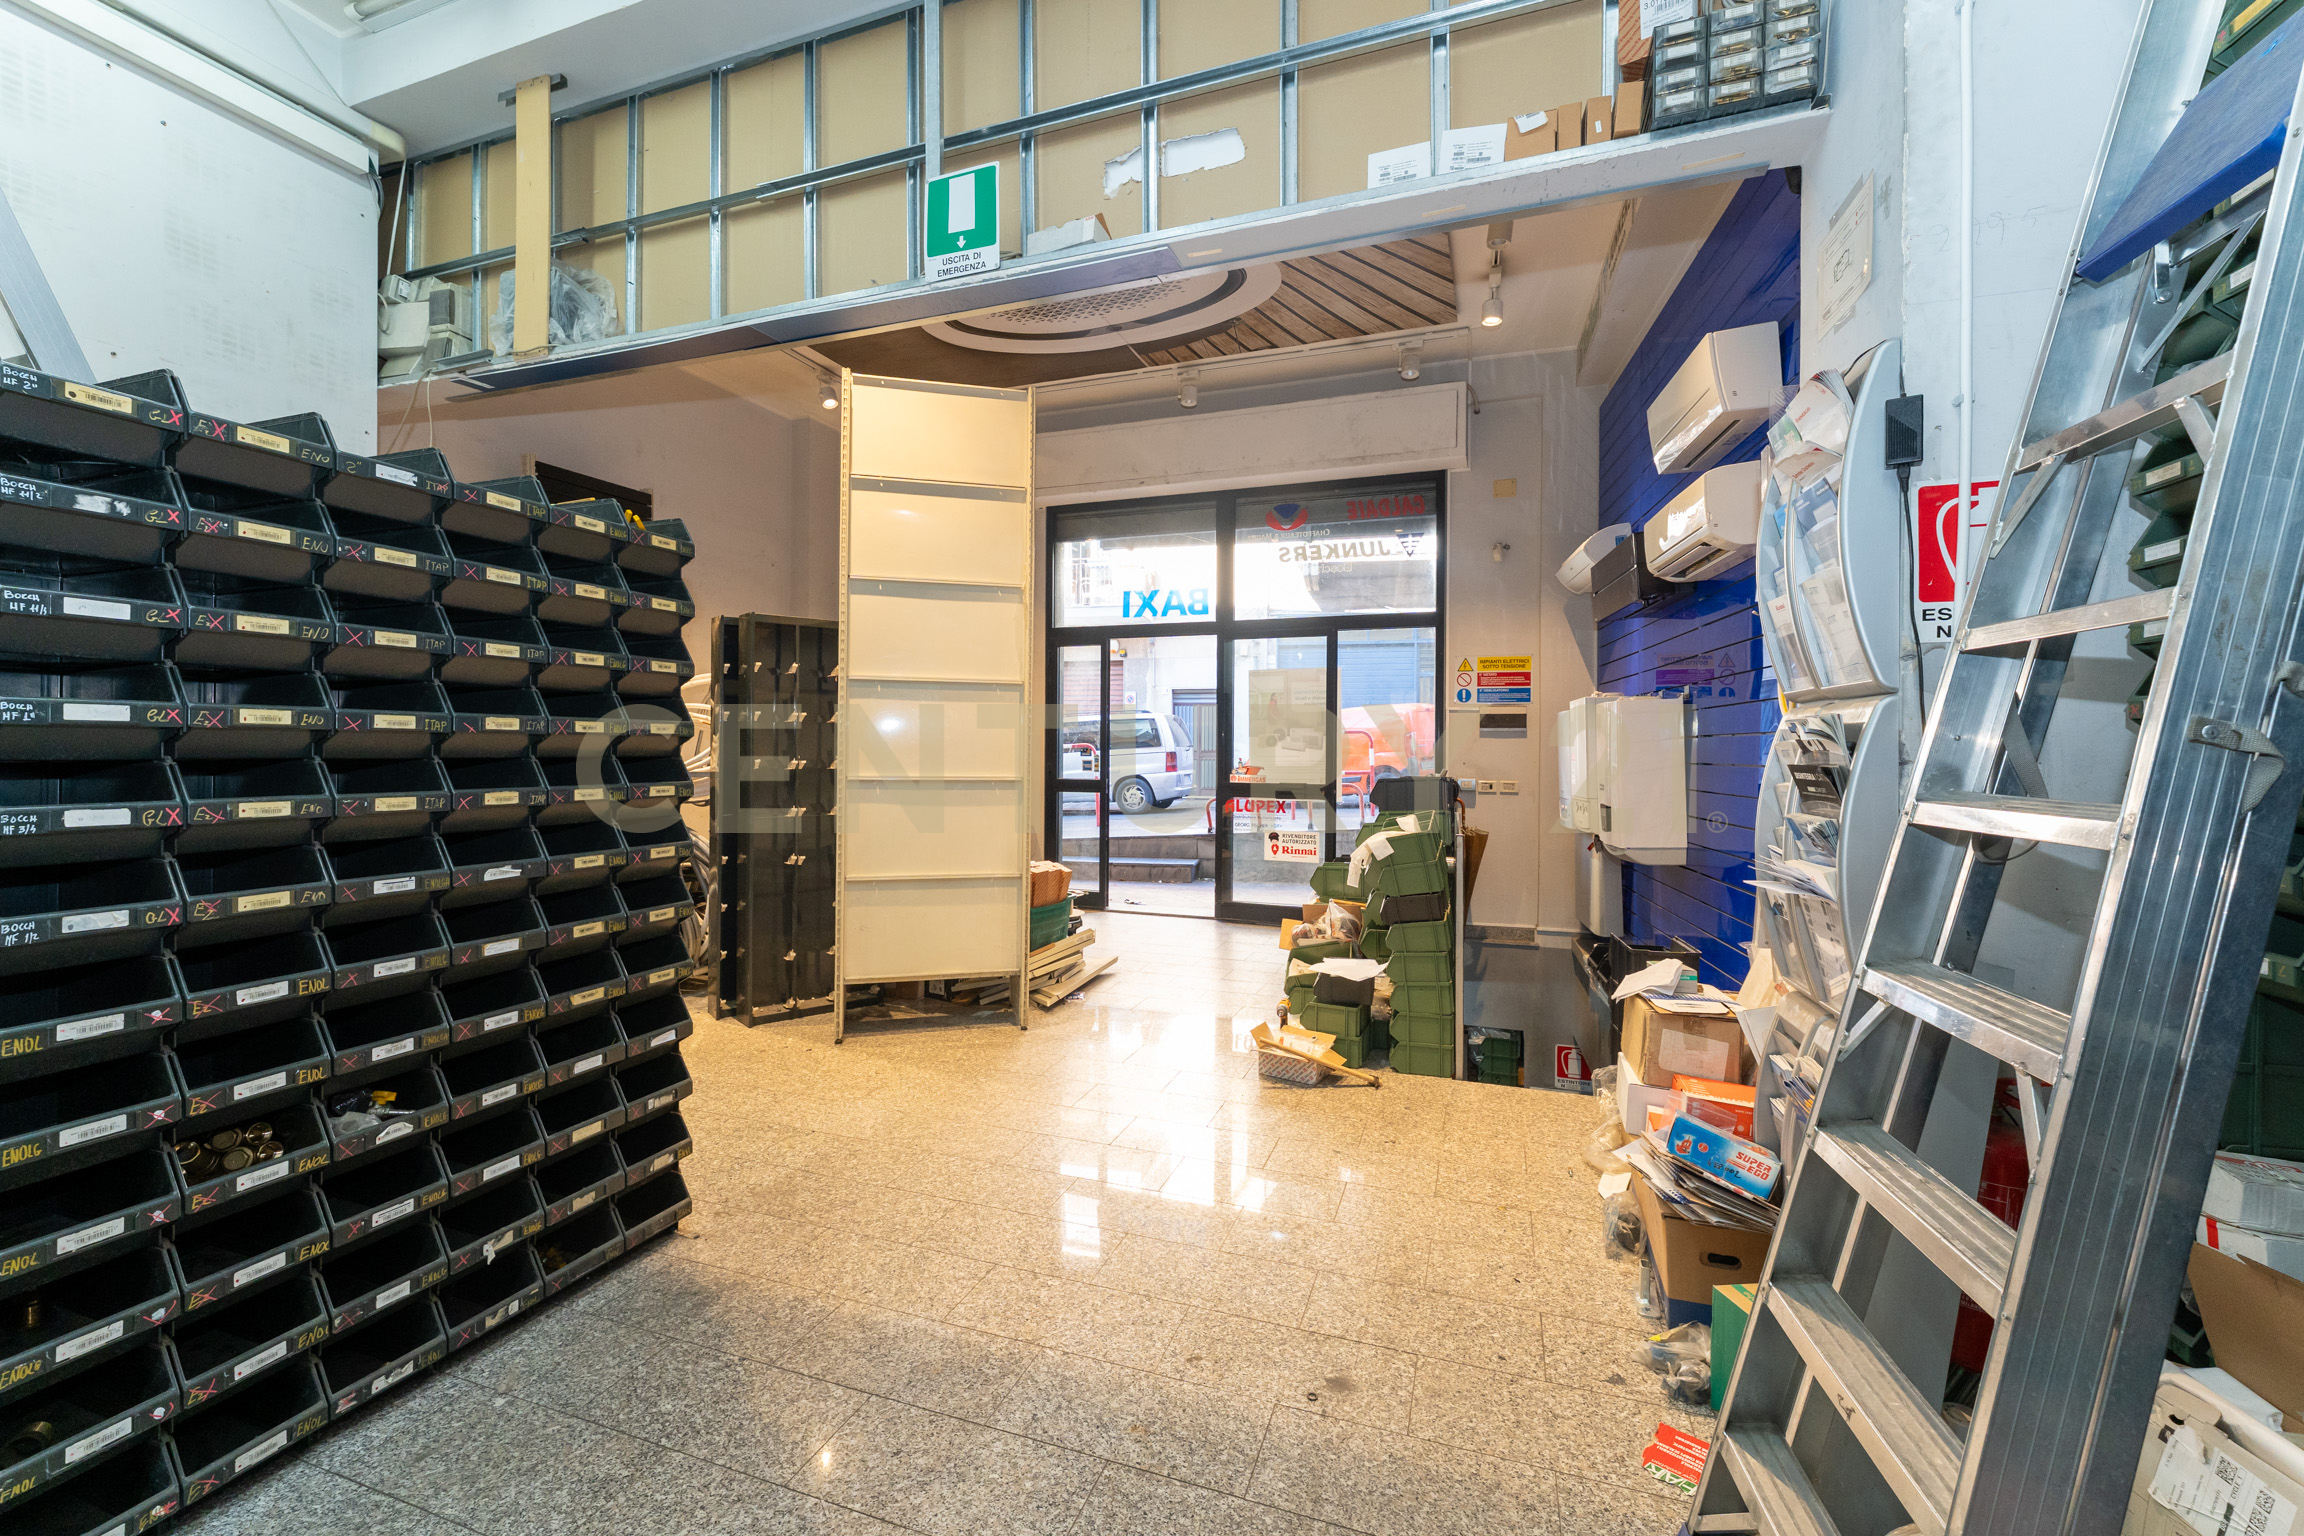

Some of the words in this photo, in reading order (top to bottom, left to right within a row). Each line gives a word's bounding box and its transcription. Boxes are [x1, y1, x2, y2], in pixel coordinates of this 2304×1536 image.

[942, 253, 970, 266] USCITA
[973, 252, 982, 260] DI
[937, 261, 987, 277] EMERGENZA
[526, 503, 546, 518] ITAP
[425, 560, 448, 572] ITAP
[527, 576, 547, 590] ITAP
[425, 639, 446, 650] ITAP
[527, 649, 544, 658] ITAP
[424, 719, 447, 732] ITAP
[526, 720, 544, 731] ITAP
[425, 797, 446, 809] ITAP
[1224, 799, 1286, 813] ALUPEX
[1282, 846, 1317, 855] Rinnai
[299, 977, 329, 995] ENOL
[1, 1035, 43, 1057] ENOL
[299, 1067, 327, 1085] ENOL
[1, 1143, 42, 1167] ENOLG
[1736, 1152, 1772, 1173] SUPER
[1747, 1166, 1770, 1180] EGO
[2230, 1480, 2241, 1500] CYCLE
